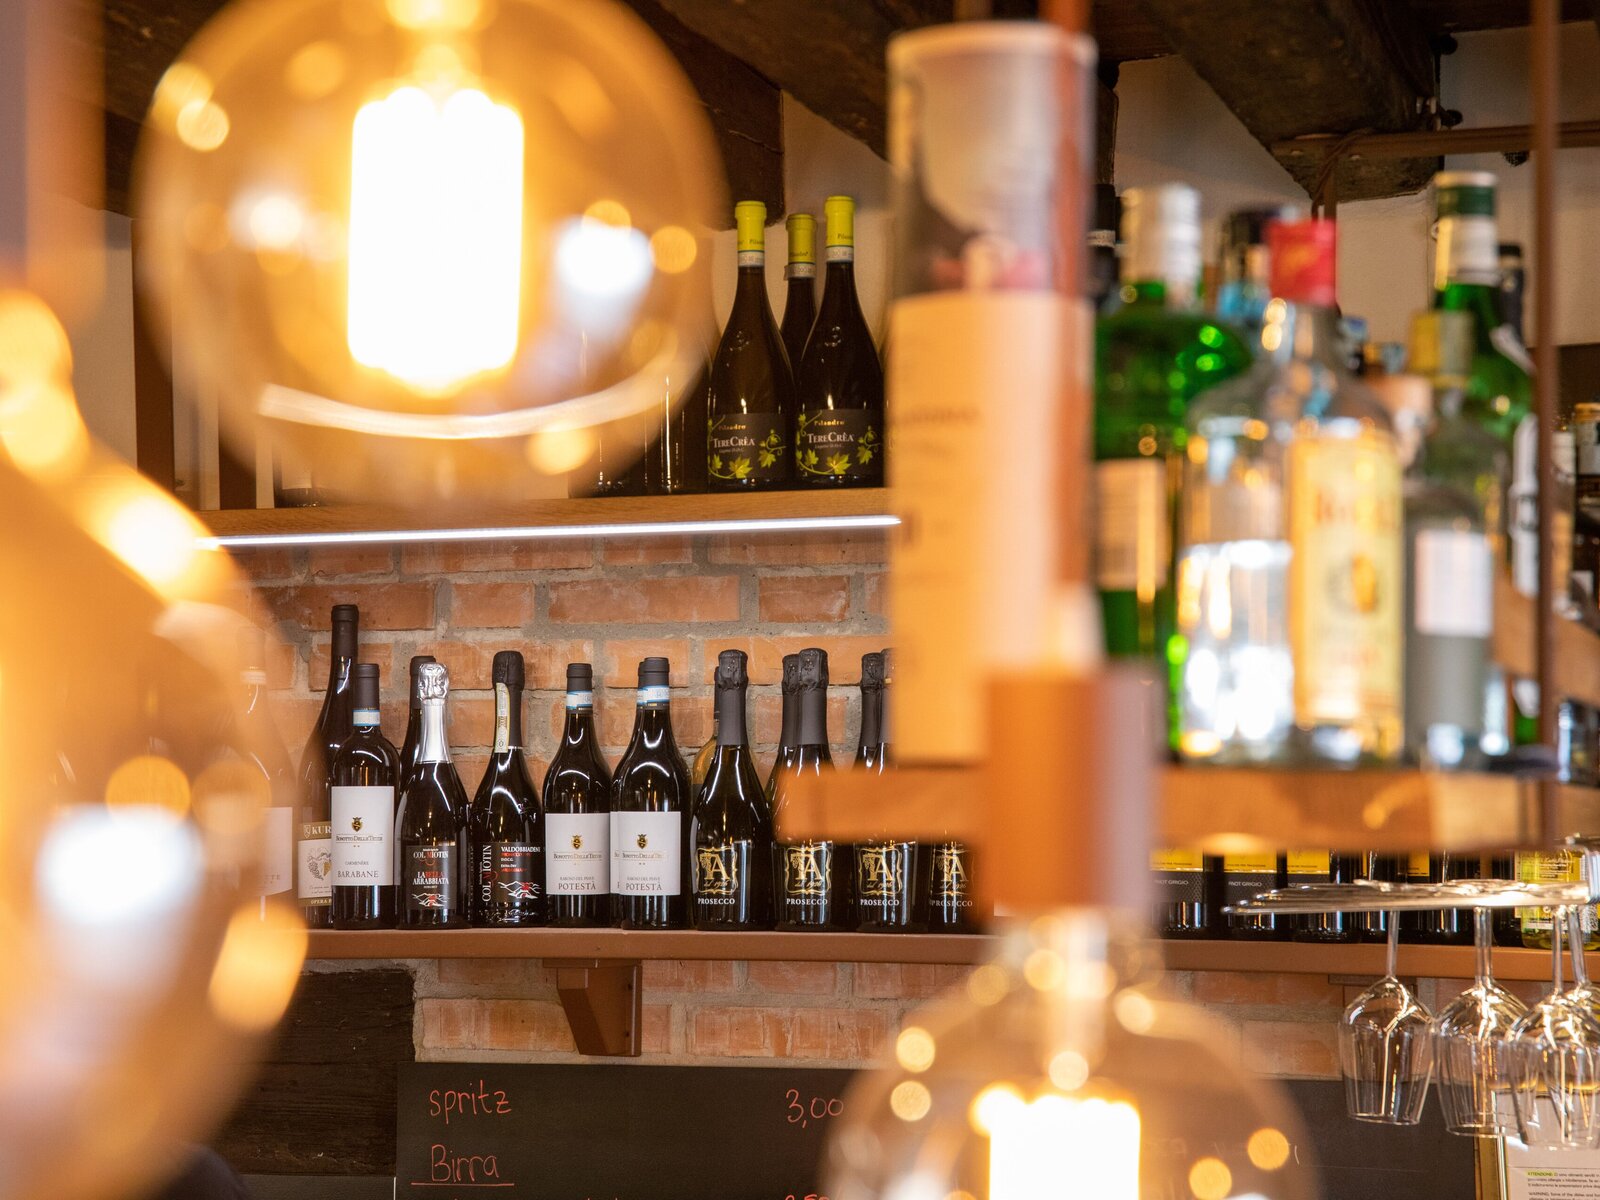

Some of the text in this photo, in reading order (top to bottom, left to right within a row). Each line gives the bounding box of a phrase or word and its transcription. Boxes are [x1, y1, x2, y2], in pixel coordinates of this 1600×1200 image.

[482, 882, 492, 902] COL
[558, 881, 596, 890] POTESTÀ
[429, 1080, 844, 1128] spritz 3,00
[431, 1144, 500, 1182] Birra
